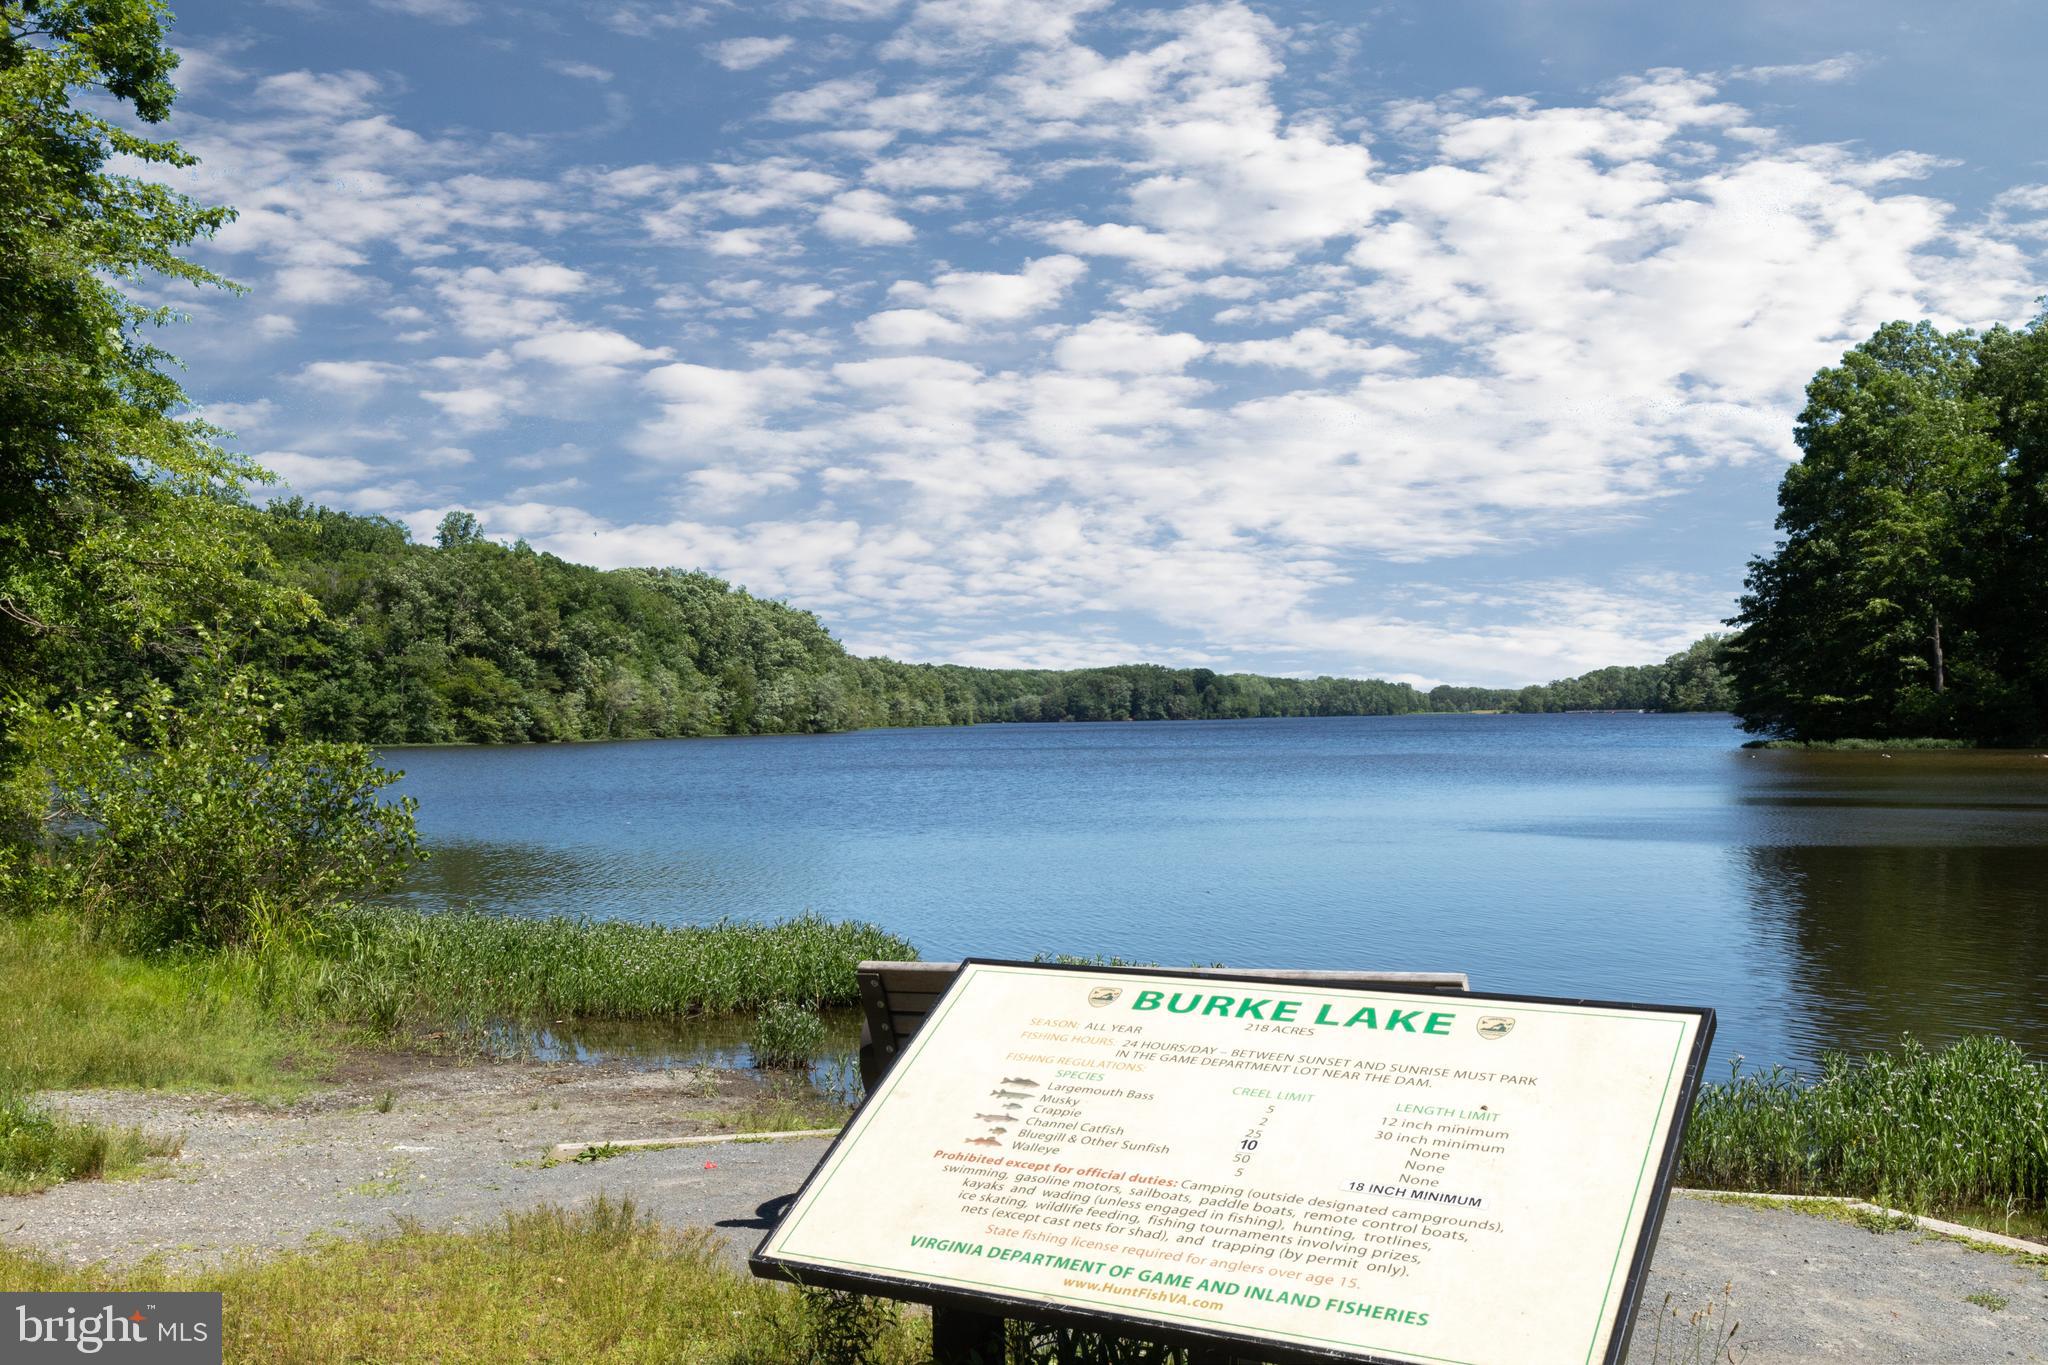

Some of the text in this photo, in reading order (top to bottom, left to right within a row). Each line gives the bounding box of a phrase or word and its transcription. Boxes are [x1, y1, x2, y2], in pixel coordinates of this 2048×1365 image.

[1131, 990, 1457, 1036] BURKE LAKE
[1084, 1022, 1106, 1031] ALL
[1111, 1024, 1143, 1035] YEAR
[1244, 1023, 1315, 1037] 218 ACRES
[1005, 1052, 1056, 1064] FISHING
[1020, 1030, 1069, 1042] FISHING
[1121, 1039, 1139, 1048] 24
[1140, 1040, 1217, 1055] HOURS/DAY
[1230, 1048, 1295, 1063] BETWEEN
[1297, 1055, 1352, 1068] SUNSET
[1353, 1060, 1386, 1071] AND
[1390, 1063, 1450, 1078] SUNRISE
[1453, 1069, 1497, 1082] MUST
[1499, 1074, 1538, 1087] PARK
[1055, 1069, 1105, 1082] SPECIES
[1115, 1049, 1432, 1088] IN THE GAME DEPARTMENT LOT NEAR THE DAM.
[1039, 1094, 1081, 1108] Musky
[1047, 1081, 1154, 1101] Largemouth Bass
[1231, 1086, 1316, 1103] CREEL LIMIT
[1033, 1104, 1082, 1118] Crappie
[1265, 1105, 1276, 1114] 5
[1395, 1103, 1501, 1123] LENGTH LIMIT
[1025, 1116, 1124, 1136] Channel Catfish
[1258, 1117, 1269, 1127] 2
[1382, 1116, 1510, 1140] 12 inch minimum
[1017, 1128, 1170, 1155] Bluegill & Other Sunfish
[1244, 1128, 1263, 1139] 25
[1374, 1130, 1505, 1155] 30 inch minimum
[1012, 1140, 1060, 1156] Walleye
[1240, 1139, 1259, 1151] 10
[1409, 1147, 1450, 1161] None
[1232, 1153, 1251, 1164] 50
[1404, 1159, 1445, 1174] None
[1234, 1167, 1245, 1177] 5
[1398, 1173, 1440, 1188] None
[933, 1149, 1504, 1233] Prohibited except for official duties: Camping (outside designated campgrounds),
[1350, 1181, 1482, 1208] 18 INCH MINIMUM
[942, 1164, 1468, 1243] swimming, gasoline motors, sailboats, paddle boats, remote control boats,
[962, 1177, 1432, 1252] kayaks and wading (unless engaged in fishing), hunting, trotlines,
[957, 1189, 1421, 1265] ice skating, wildlife feeding, fishing tournaments involving prizes,
[960, 1205, 1409, 1278] nets (except cast nets for shad), and trapping (by permit only).
[984, 1224, 1361, 1290] State fishing license required for anglers over age 15.
[910, 1235, 1430, 1327] VIRGINIA DEPARTMENT OF GAME AND INLAND FISHERIES
[1063, 1278, 1224, 1311] www.HuntFishVA.com
